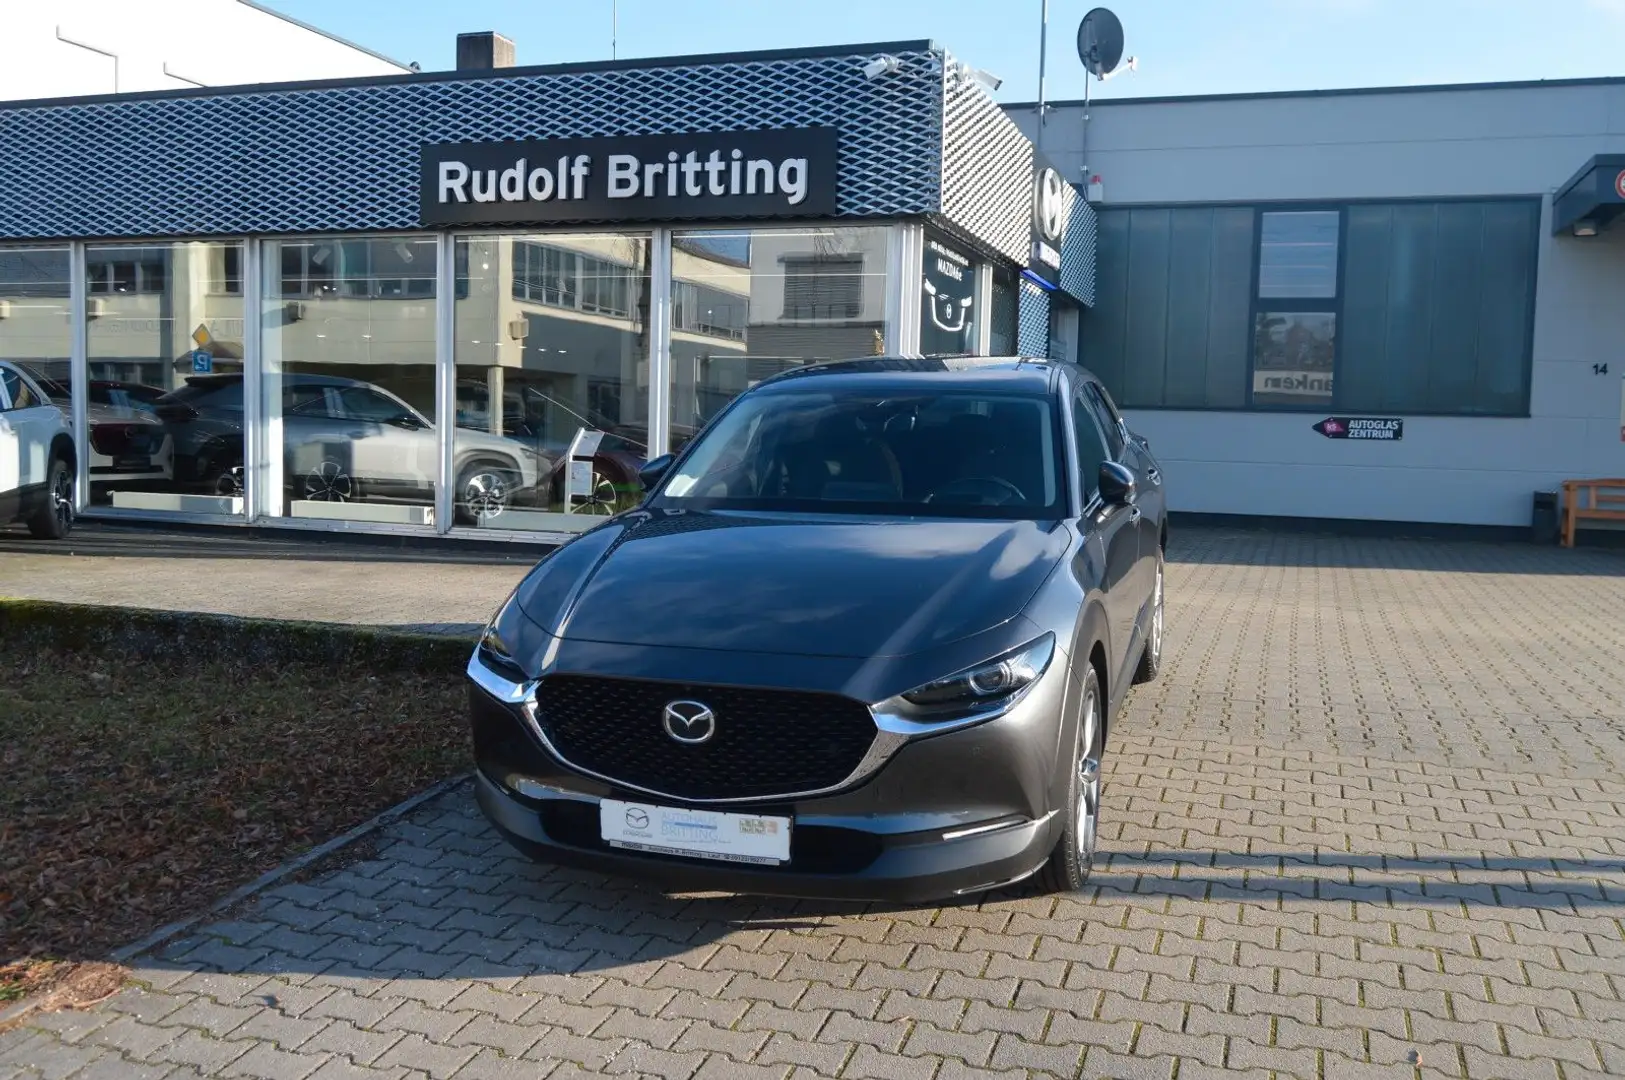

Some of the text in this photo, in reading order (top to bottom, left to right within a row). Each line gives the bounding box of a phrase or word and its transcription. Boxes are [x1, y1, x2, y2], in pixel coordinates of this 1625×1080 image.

[438, 148, 808, 205] Rudolf Britting
[1593, 363, 1608, 376] 14
[1348, 420, 1399, 430] AUTOGLAS
[1347, 429, 1394, 439] ZENTRUM
[661, 825, 718, 841] BRITTING
